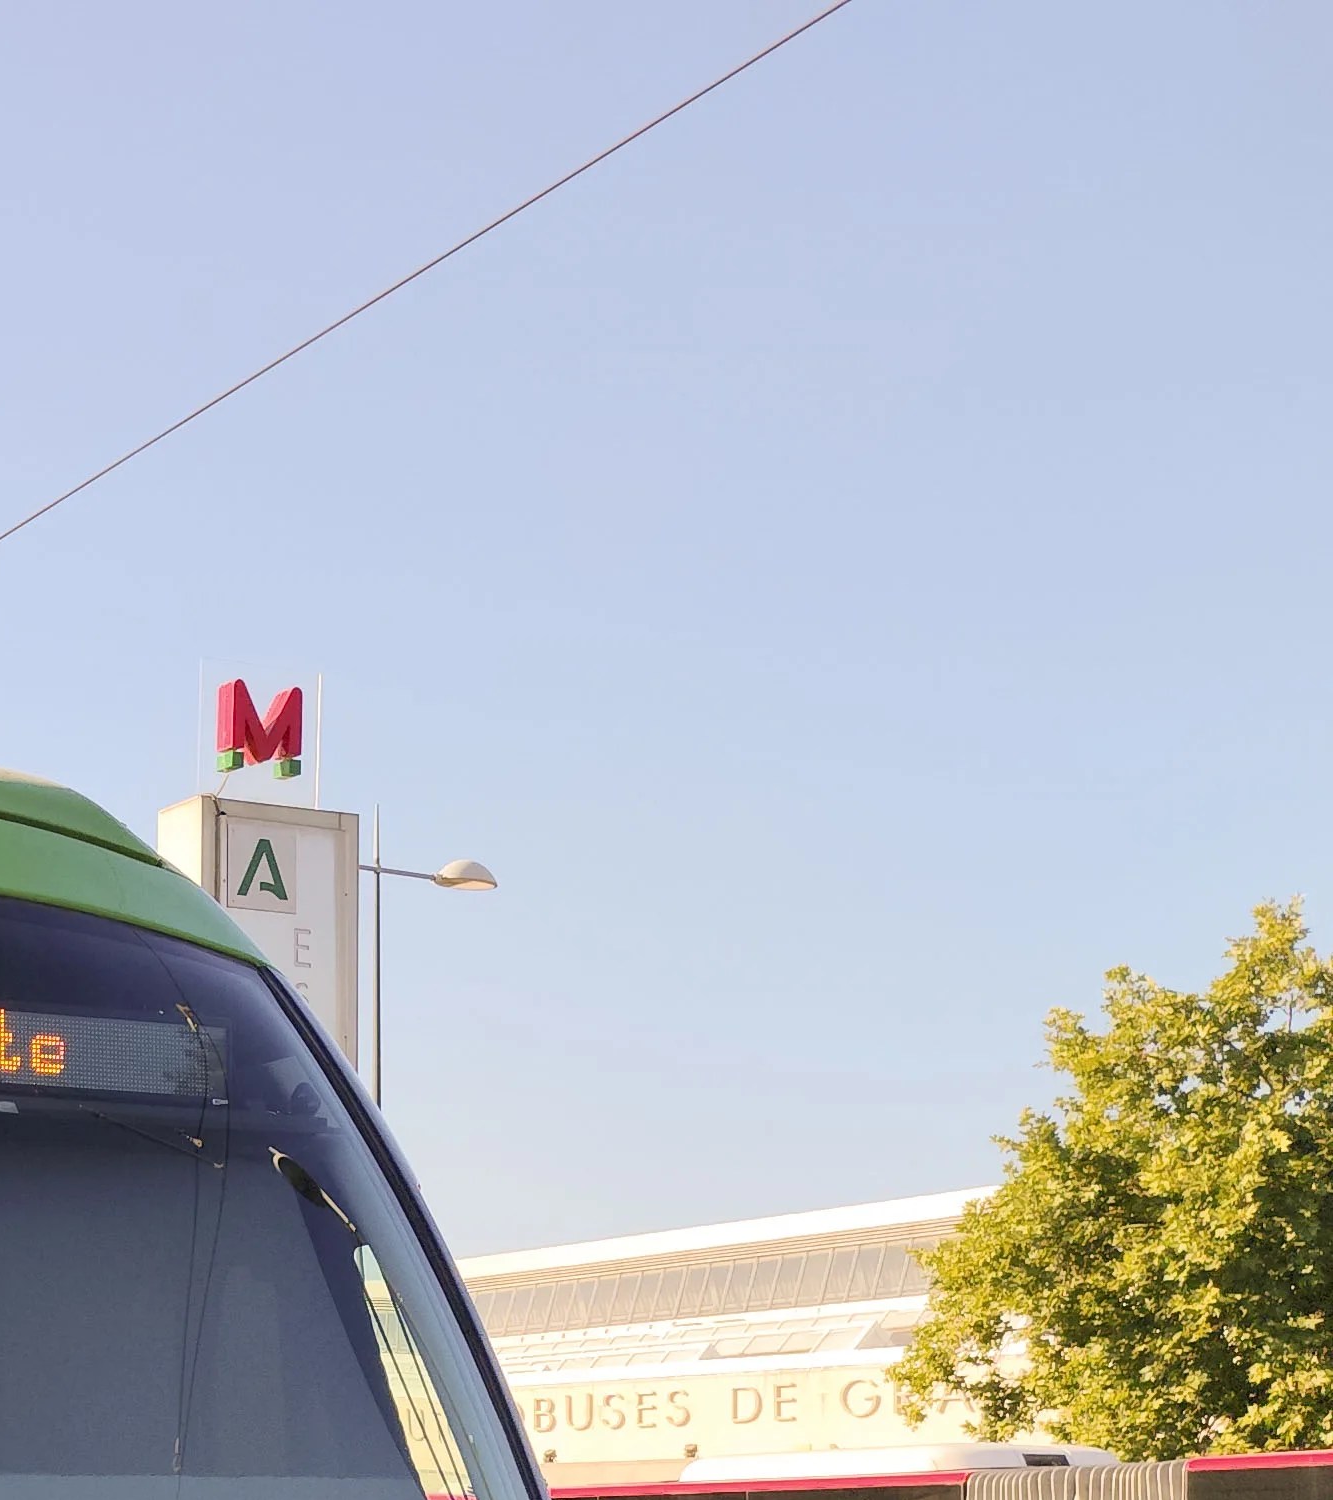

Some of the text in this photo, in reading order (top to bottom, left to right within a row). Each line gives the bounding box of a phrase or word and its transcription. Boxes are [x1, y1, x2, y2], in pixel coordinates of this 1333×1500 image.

[216, 678, 303, 780] M
[517, 1389, 691, 1433] BUSES
[732, 1382, 797, 1424] DE
